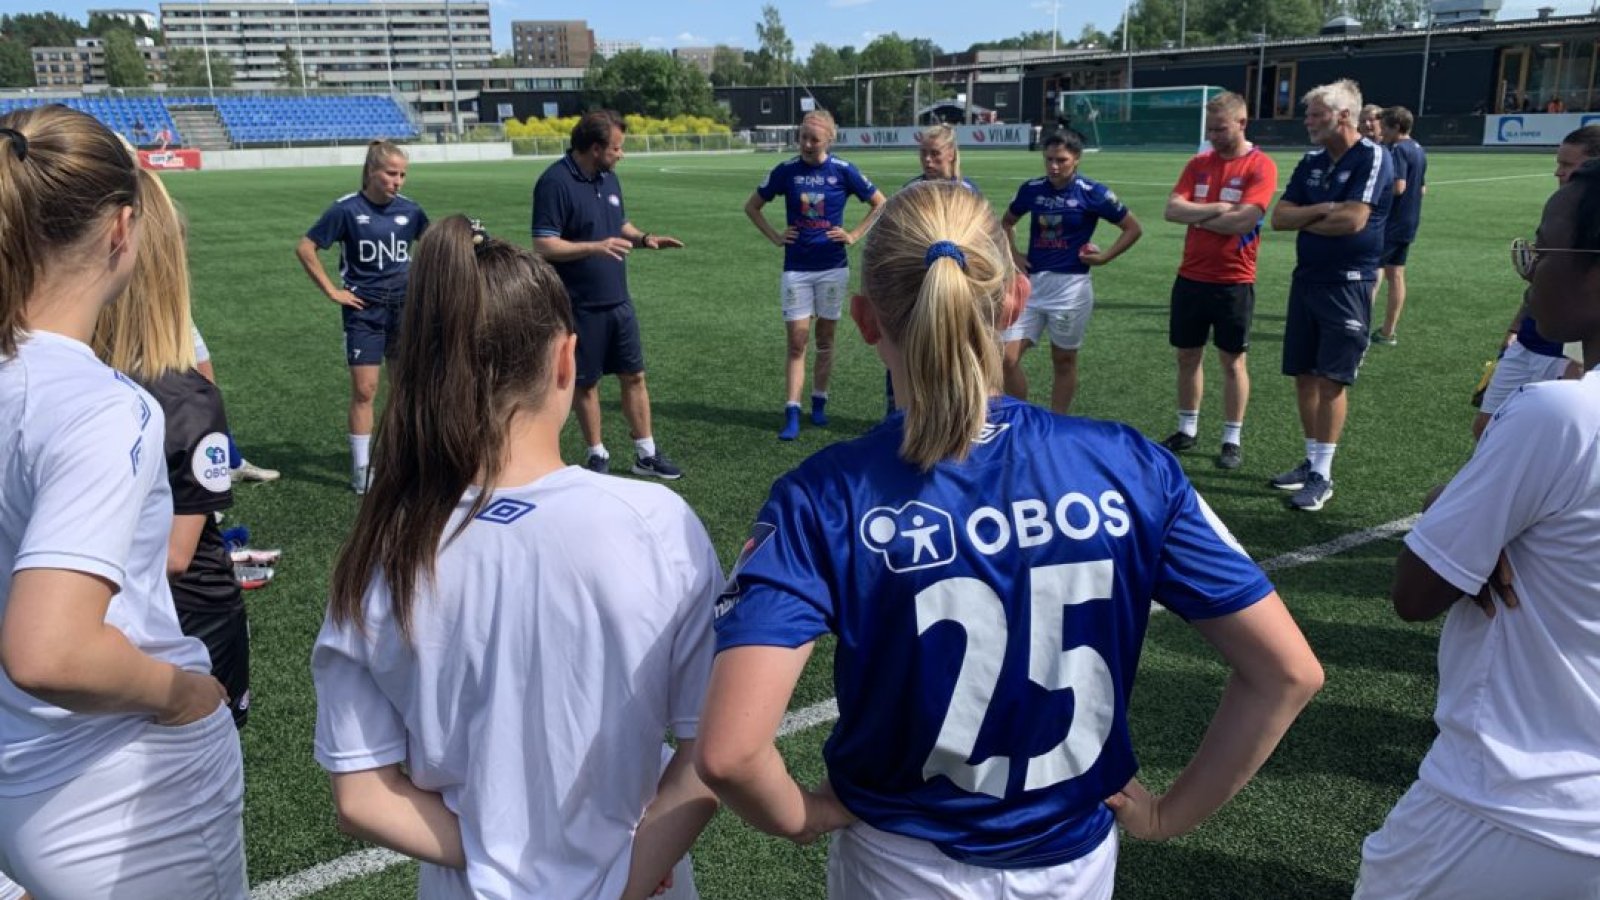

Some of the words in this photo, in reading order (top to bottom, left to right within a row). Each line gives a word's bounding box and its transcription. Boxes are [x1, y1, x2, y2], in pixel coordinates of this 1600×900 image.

[359, 232, 407, 270] DNB
[205, 467, 229, 479] OBO
[966, 489, 1130, 556] OBOS
[914, 559, 1114, 800] 25
